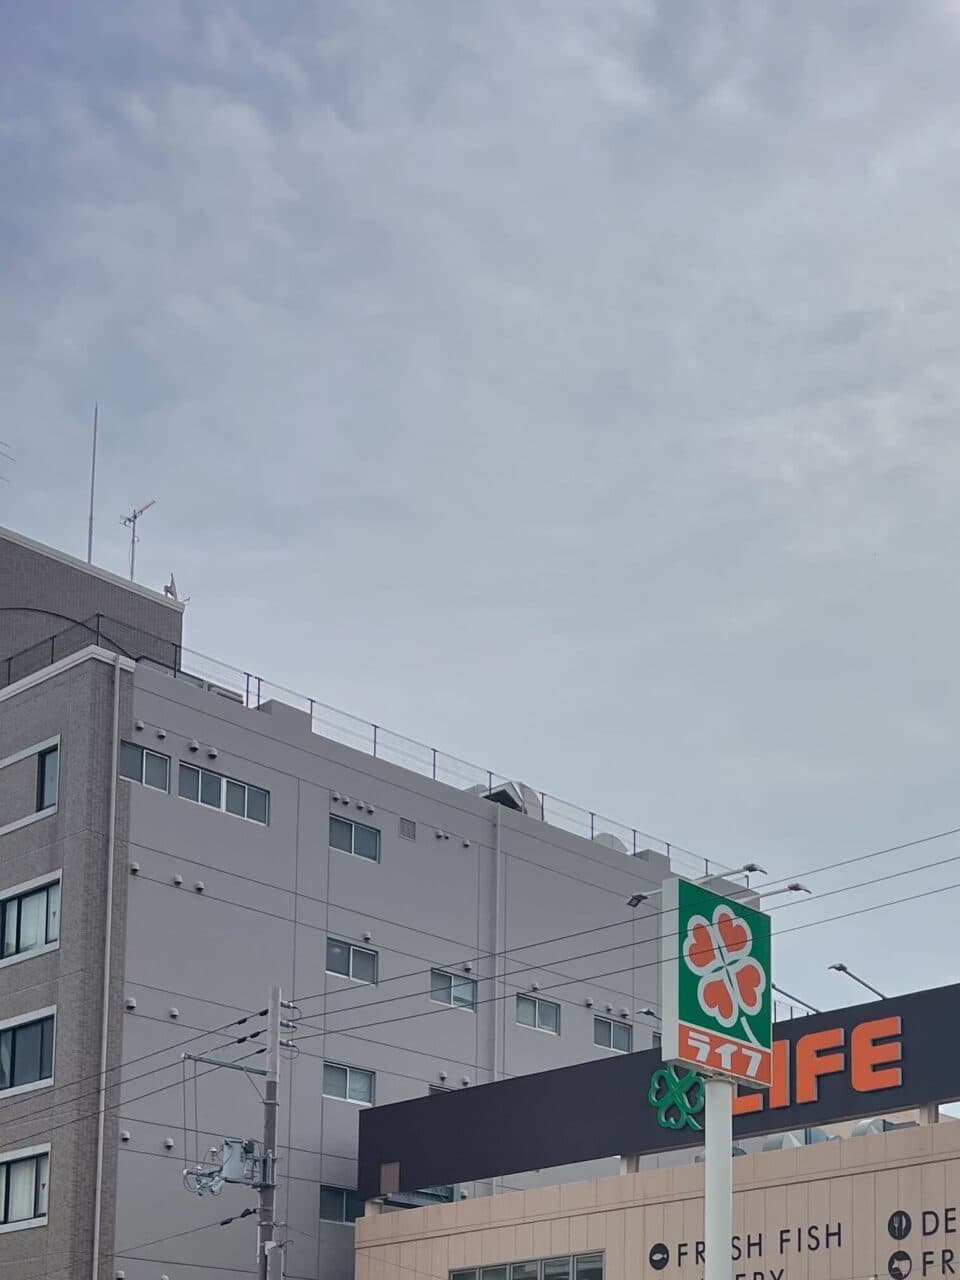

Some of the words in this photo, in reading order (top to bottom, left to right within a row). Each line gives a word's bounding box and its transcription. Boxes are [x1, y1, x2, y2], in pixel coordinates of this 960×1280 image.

[687, 1031, 762, 1077] ライフ
[677, 1233, 763, 1268] FRSH
[779, 1222, 842, 1255] FISH
